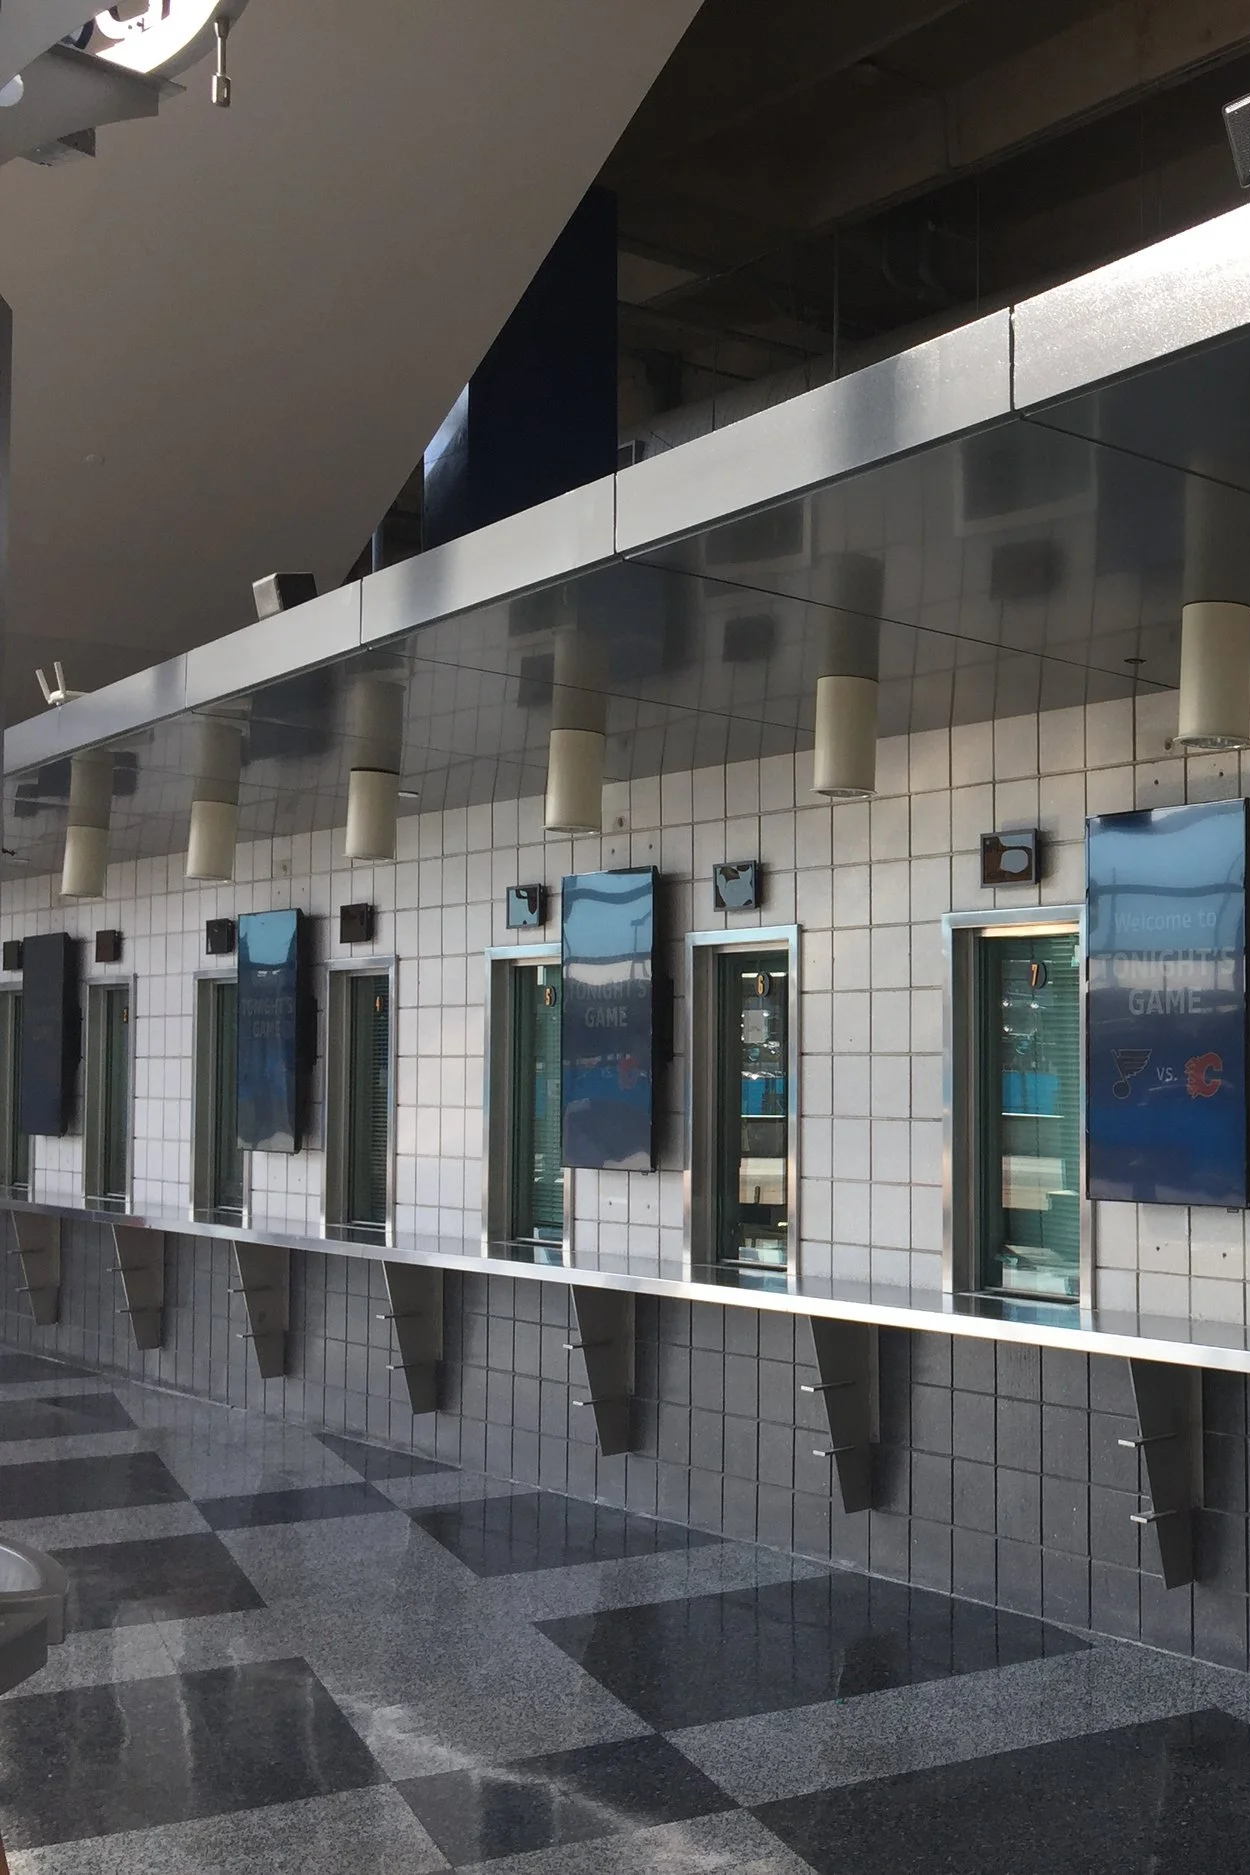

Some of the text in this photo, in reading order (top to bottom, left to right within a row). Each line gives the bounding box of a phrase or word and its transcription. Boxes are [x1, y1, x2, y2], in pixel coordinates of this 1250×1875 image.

[1114, 909, 1218, 934] Welcome to
[1094, 946, 1236, 981] TONIGHT'S
[1128, 988, 1203, 1016] GAME
[584, 1005, 629, 1028] GAME
